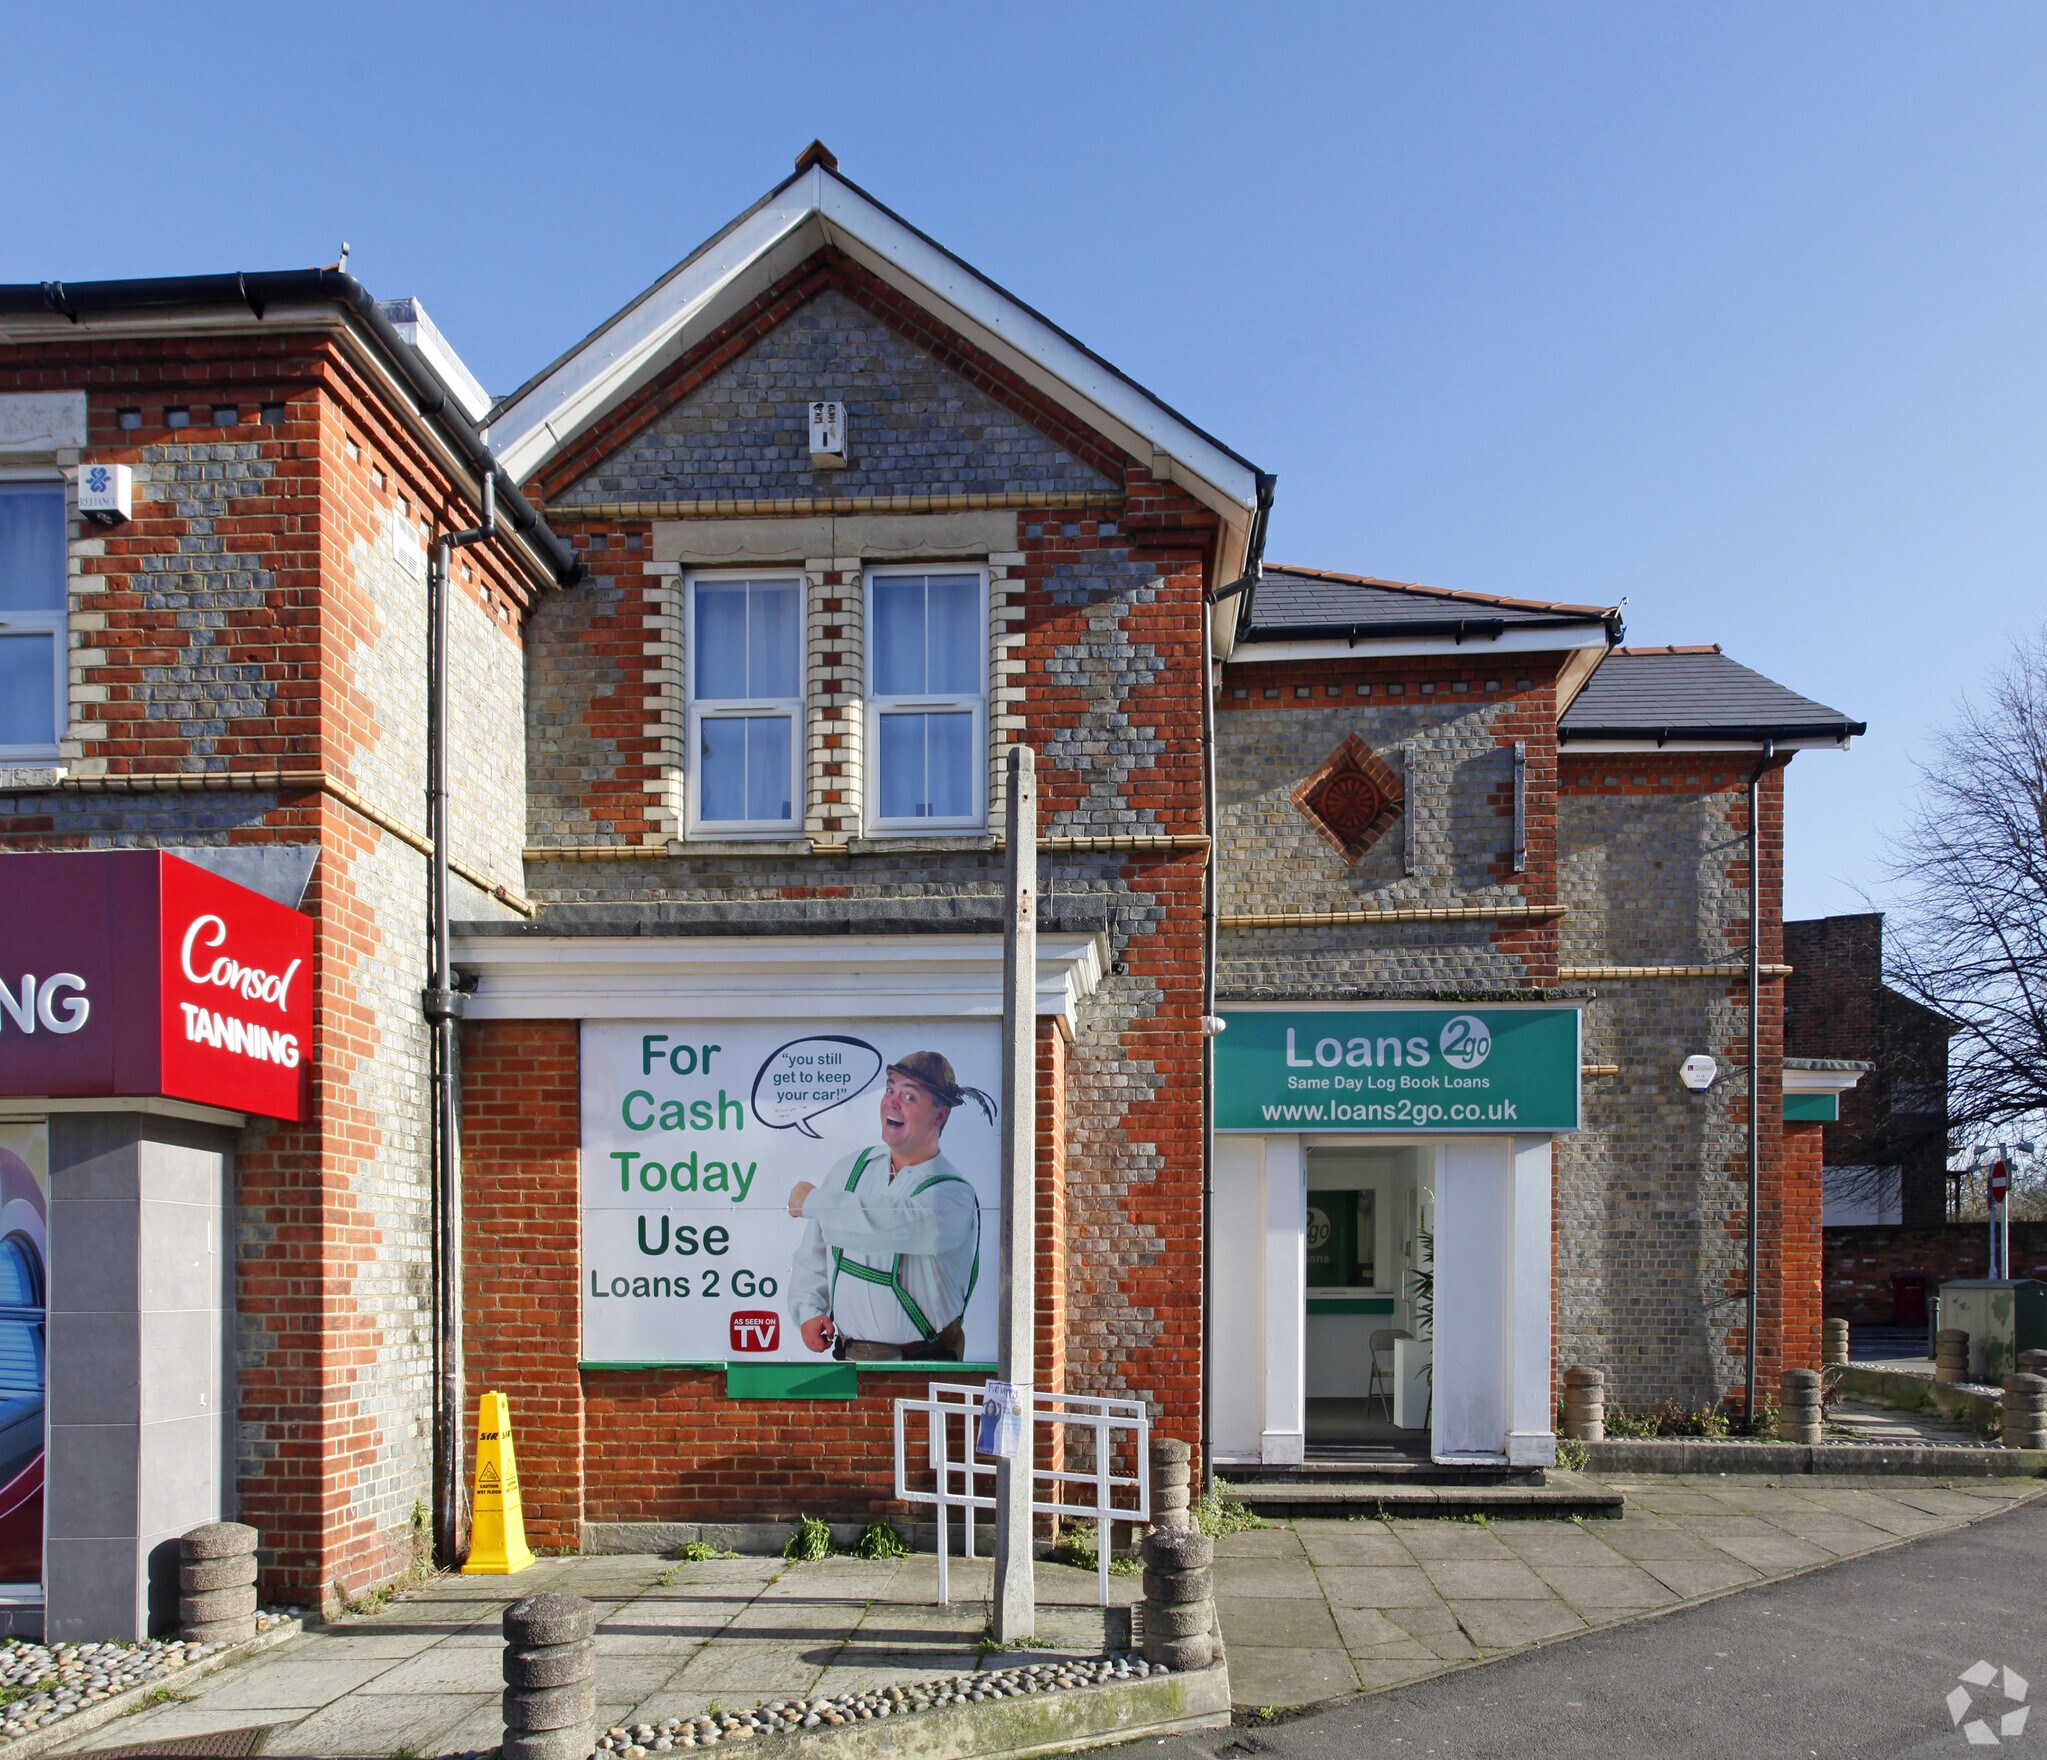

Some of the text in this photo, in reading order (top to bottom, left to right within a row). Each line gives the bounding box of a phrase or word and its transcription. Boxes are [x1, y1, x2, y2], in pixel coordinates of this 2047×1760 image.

[80, 497, 116, 506] RELIANCE
[181, 914, 302, 1013] Consol
[180, 1002, 300, 1068] TANNING
[1286, 1019, 1490, 1068] Loans 2go
[642, 1035, 722, 1076] For
[817, 1053, 842, 1065] still
[773, 1071, 851, 1086] get to keep
[1287, 1075, 1490, 1092] Same Day Log Book Loans
[622, 1089, 744, 1131] Cash
[777, 1091, 808, 1103] your
[1262, 1099, 1518, 1126] www.loans2go.co.uk
[609, 1151, 757, 1203] Today
[637, 1215, 730, 1256] Use
[591, 1269, 778, 1298] Loans 2 Go
[733, 1325, 776, 1348] TV
